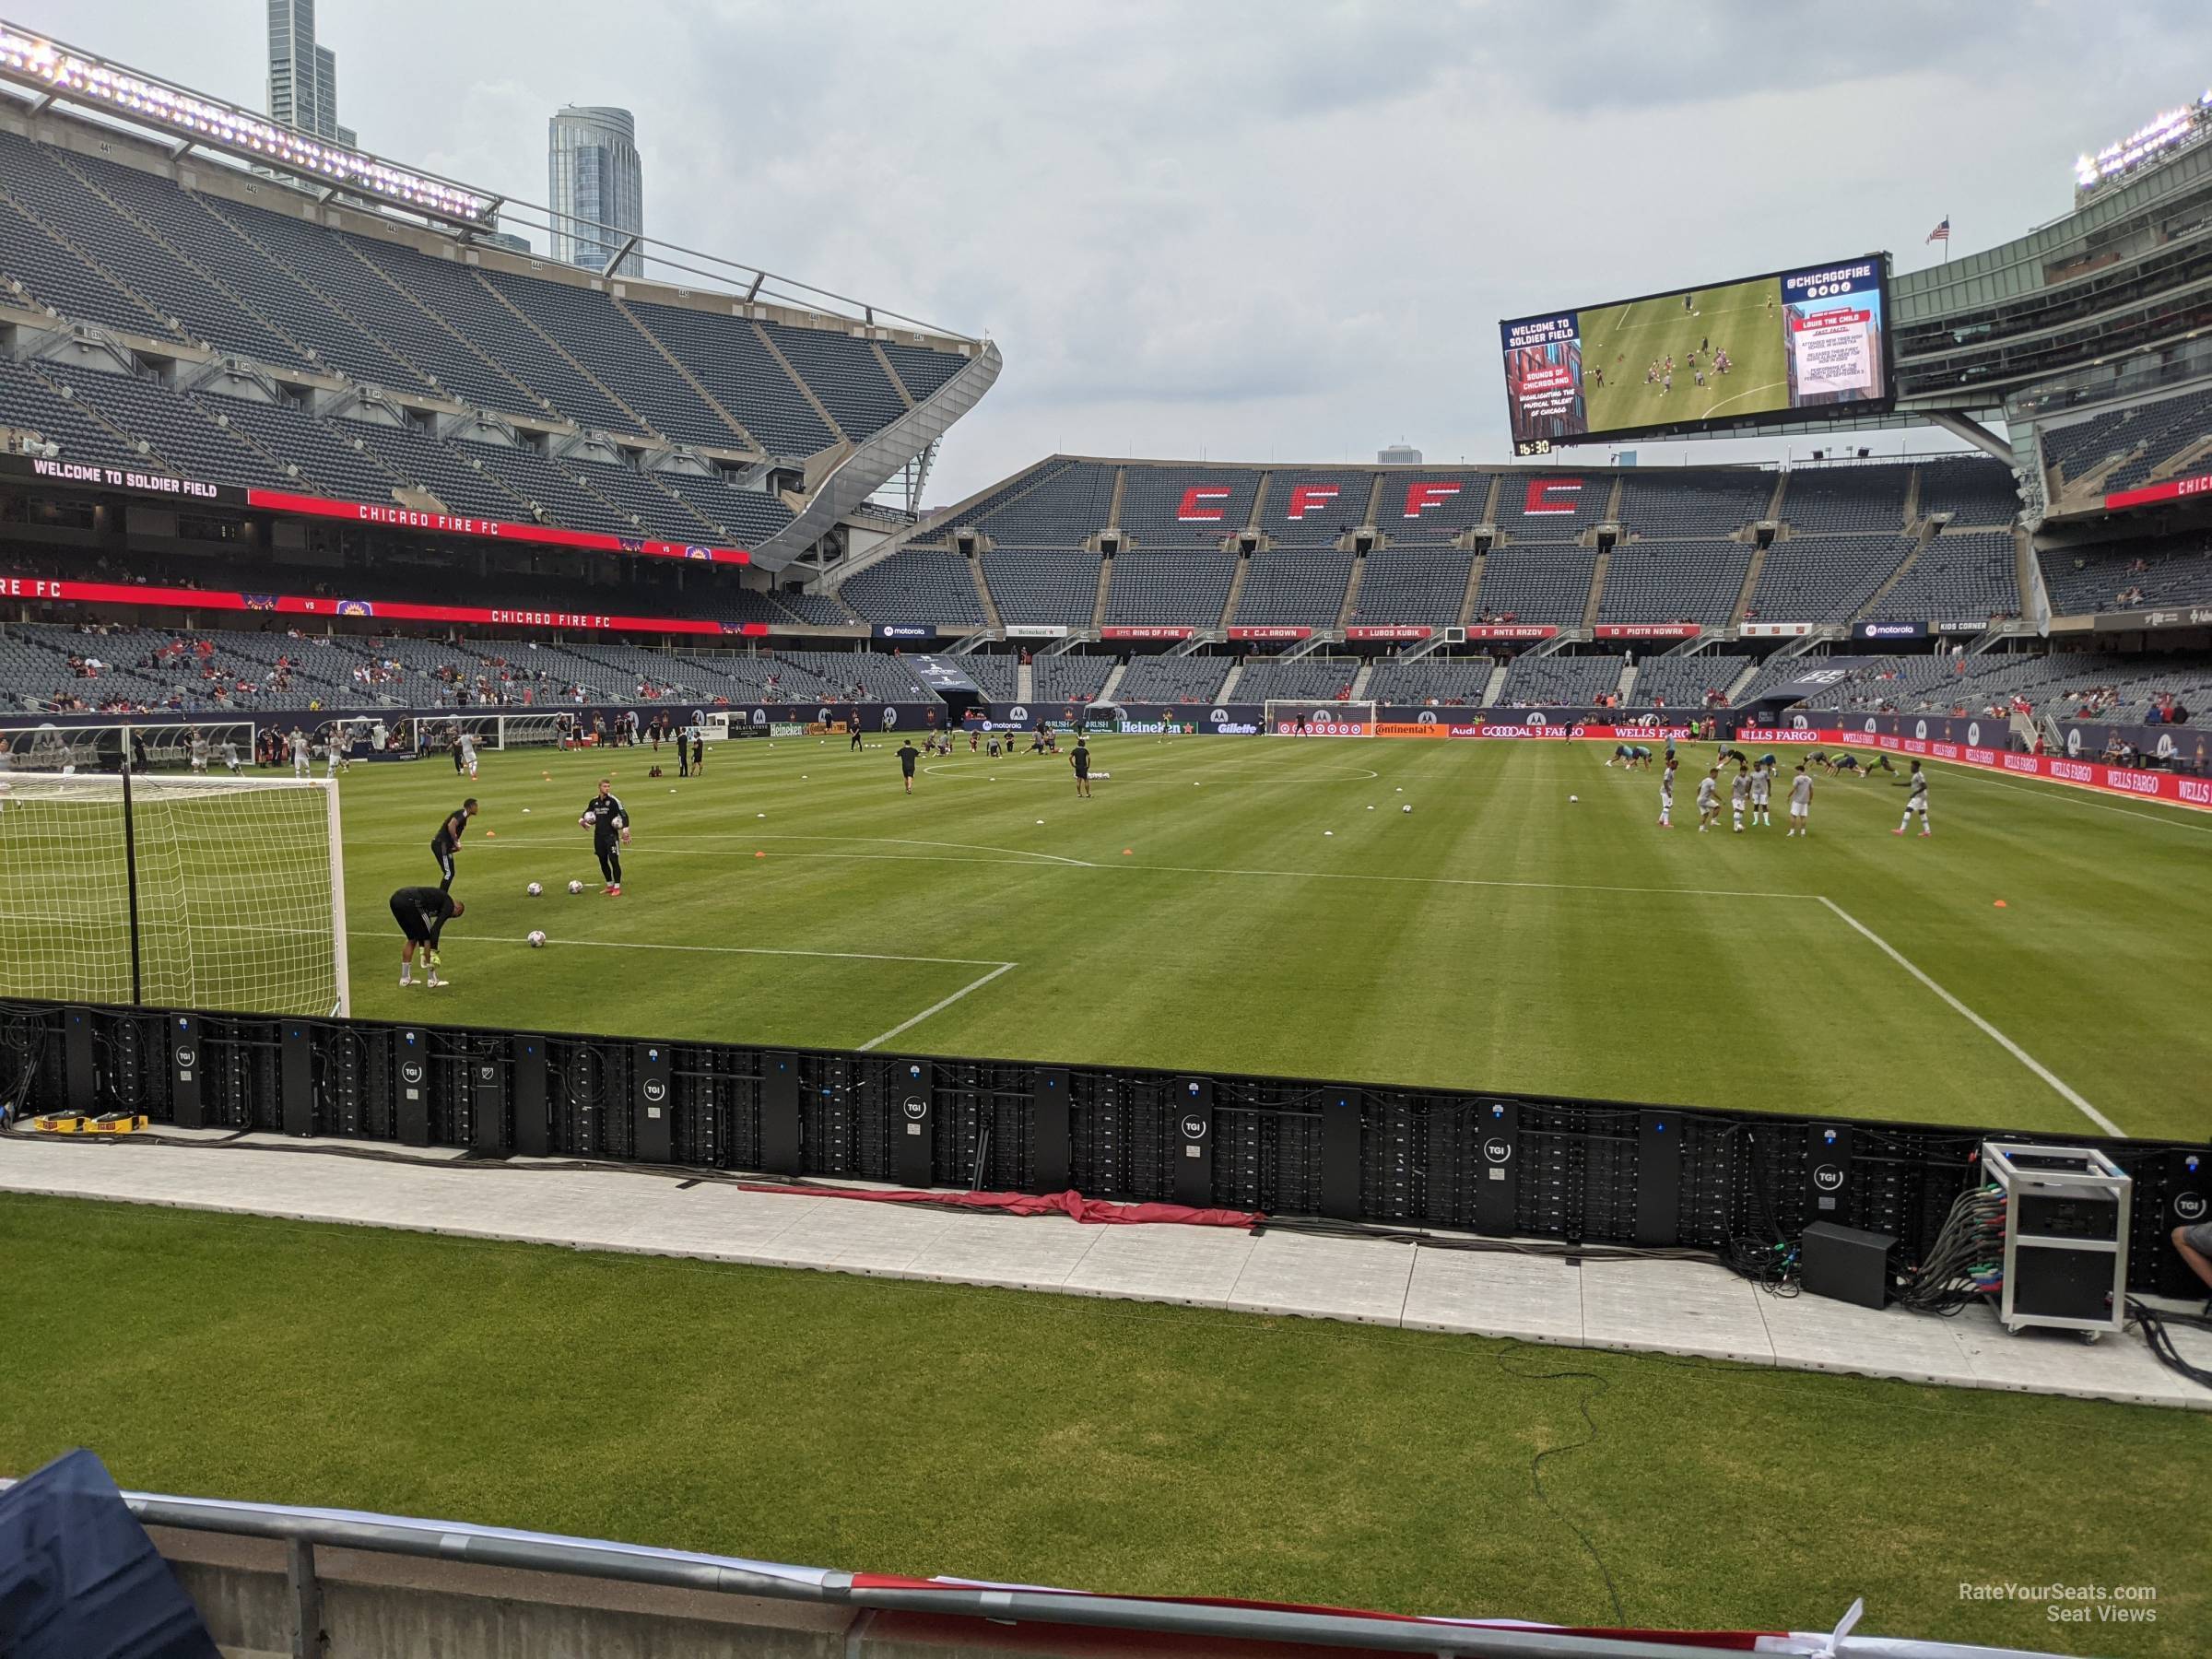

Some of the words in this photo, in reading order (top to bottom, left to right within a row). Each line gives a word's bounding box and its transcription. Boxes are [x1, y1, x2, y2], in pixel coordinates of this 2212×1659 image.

[100, 142, 112, 154] 441
[246, 184, 257, 194] 442
[532, 261, 542, 270] 444
[1787, 265, 1871, 288] @CHICAGOFIRE
[1824, 317, 1837, 325] THE
[1512, 321, 1555, 336] WELCOME
[1558, 319, 1569, 328] TO
[1510, 333, 1546, 347] SOLDIER
[1548, 328, 1573, 340] FIELD
[1526, 371, 1553, 381] SOUNDS
[1523, 378, 1569, 390] CHICAGOLAND
[1519, 390, 1561, 402] HIGHLIGHTING
[1562, 388, 1574, 396] THE
[1524, 400, 1549, 409] MUSICAL
[1550, 396, 1574, 406] TALENT
[1540, 406, 1567, 416] CHICAGO
[1520, 440, 1549, 455] 16:30
[34, 460, 101, 483] WELCOME
[105, 469, 122, 485] TO
[126, 473, 180, 493] SOLDIER
[183, 481, 218, 498] FIELD
[2178, 475, 2212, 495] CHIC
[359, 505, 429, 527] CHICAGO
[439, 515, 472, 532] FIRE
[481, 521, 499, 535] FC
[37, 582, 60, 598] FC
[305, 602, 314, 610] VS
[492, 610, 550, 625] CHICAGO
[559, 614, 587, 627] FIRE
[595, 616, 610, 628] FC
[894, 627, 925, 636] motorola
[1877, 626, 1913, 635] motorola
[1940, 623, 1957, 631] KIDS
[1959, 622, 1987, 631] CORNER
[1132, 629, 1150, 637] RING
[1151, 629, 1161, 637] OF
[1163, 629, 1180, 637] FIRE
[1516, 629, 1543, 637] RAZOV
[1611, 628, 1619, 636] 10
[1627, 628, 1651, 636] PIOTR
[1653, 628, 1684, 636] NOWAK
[993, 722, 1022, 730] motorola
[1051, 720, 1069, 728] RUSH
[1090, 720, 1109, 728] RUSH
[1122, 721, 1181, 734] Heineken
[1218, 723, 1257, 735] Gillette
[771, 723, 802, 737] Heineken
[1376, 724, 1427, 735] Continental
[1452, 727, 1475, 735] Audi
[1615, 728, 1655, 737] WELLS
[1741, 731, 1772, 740] WELLS
[1776, 730, 1818, 741] FARGO
[1843, 733, 1862, 742] WELLS
[1933, 743, 1945, 755] WELLS
[1945, 745, 1957, 759] FARGO
[1965, 748, 1979, 761] WELLS
[1980, 751, 1994, 765] FARGO
[2004, 754, 2020, 769] WELLS
[2020, 758, 2038, 772] FARGO
[2051, 761, 2071, 778] WELLS
[2072, 765, 2092, 782] FARGO
[2108, 770, 2131, 790] WELLS
[2132, 774, 2159, 794] FARGO
[2179, 781, 2210, 803] WELLS
[406, 1068, 418, 1077] TGI
[646, 1086, 660, 1094] TGI
[1186, 1123, 1200, 1131] TGI
[1489, 1146, 1504, 1154] TGI
[1819, 1172, 1836, 1182] TGI
[2181, 1200, 2199, 1210] TGI
